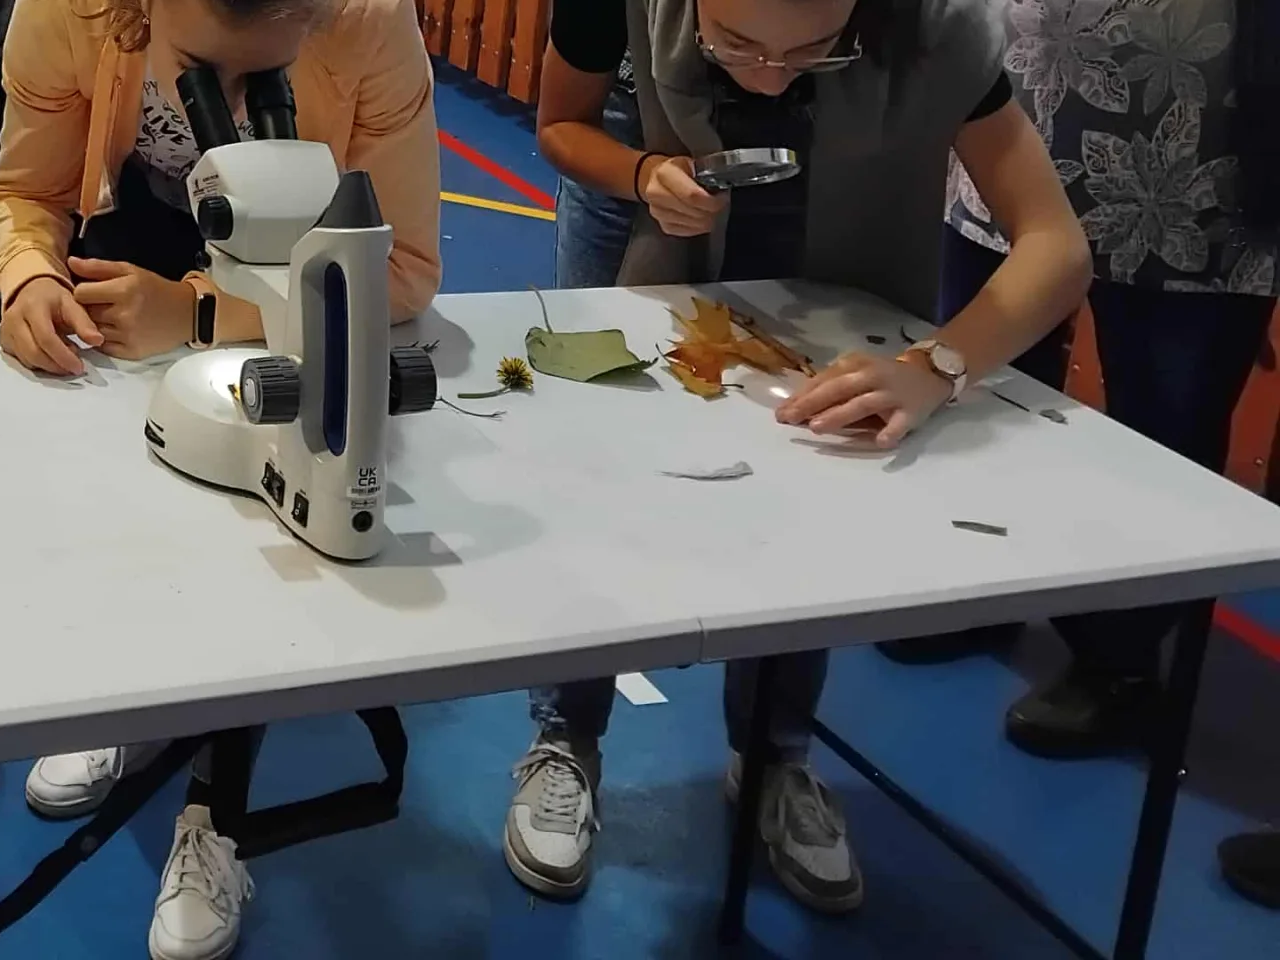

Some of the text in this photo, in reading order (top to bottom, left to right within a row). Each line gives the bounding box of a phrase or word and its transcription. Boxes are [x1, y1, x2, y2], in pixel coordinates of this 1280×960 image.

[143, 106, 192, 145] LIVE
[359, 466, 377, 477] UK
[358, 477, 377, 487] CA
